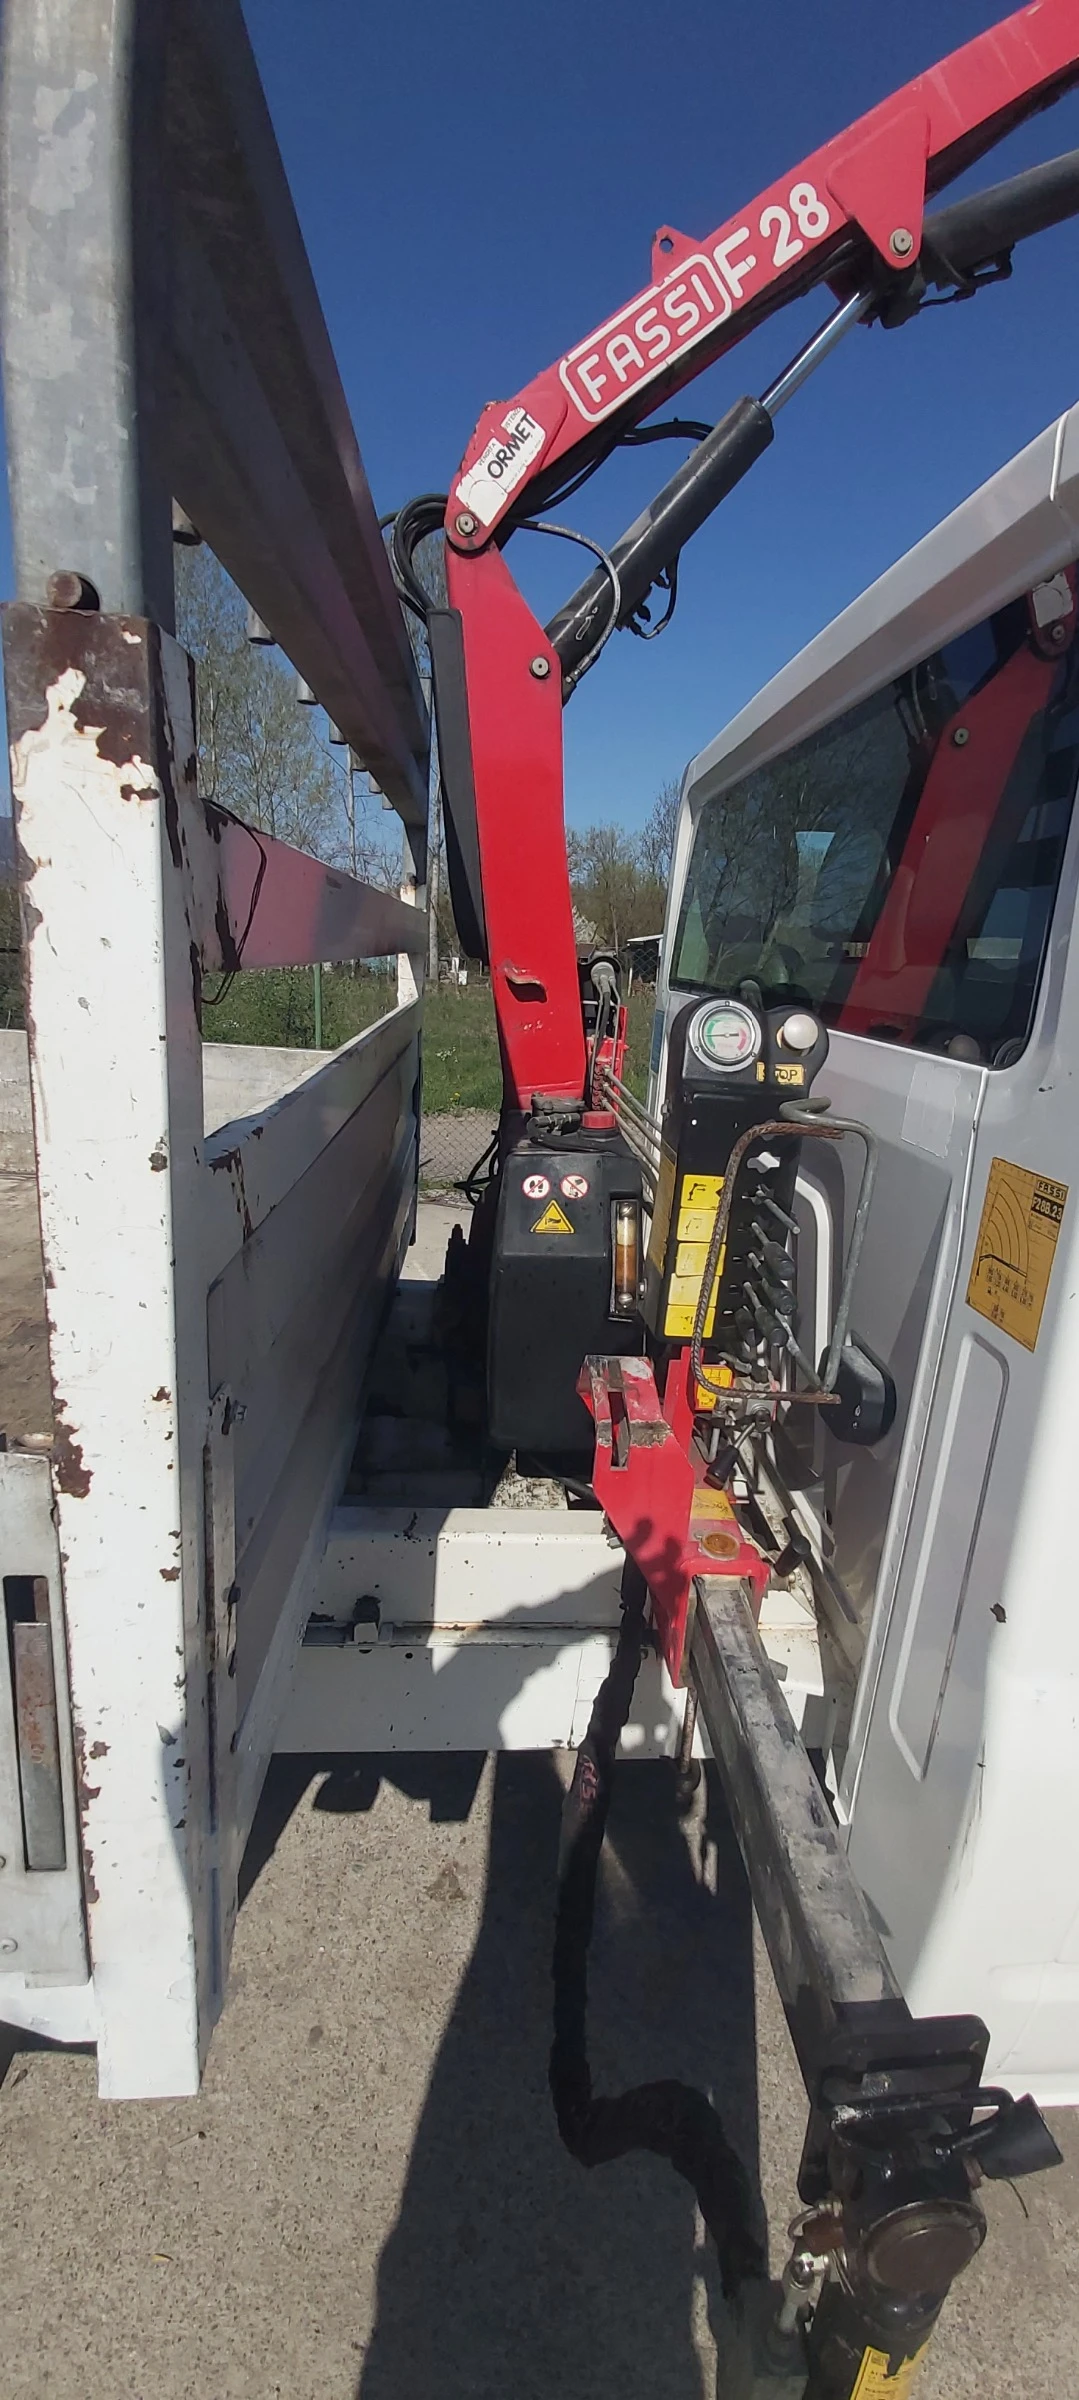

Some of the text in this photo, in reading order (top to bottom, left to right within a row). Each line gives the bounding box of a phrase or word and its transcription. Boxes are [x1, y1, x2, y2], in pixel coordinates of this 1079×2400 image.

[576, 273, 715, 403] FASSI
[759, 181, 830, 268] 28
[487, 414, 536, 479] ORMET
[1038, 1180, 1065, 1200] FASSI
